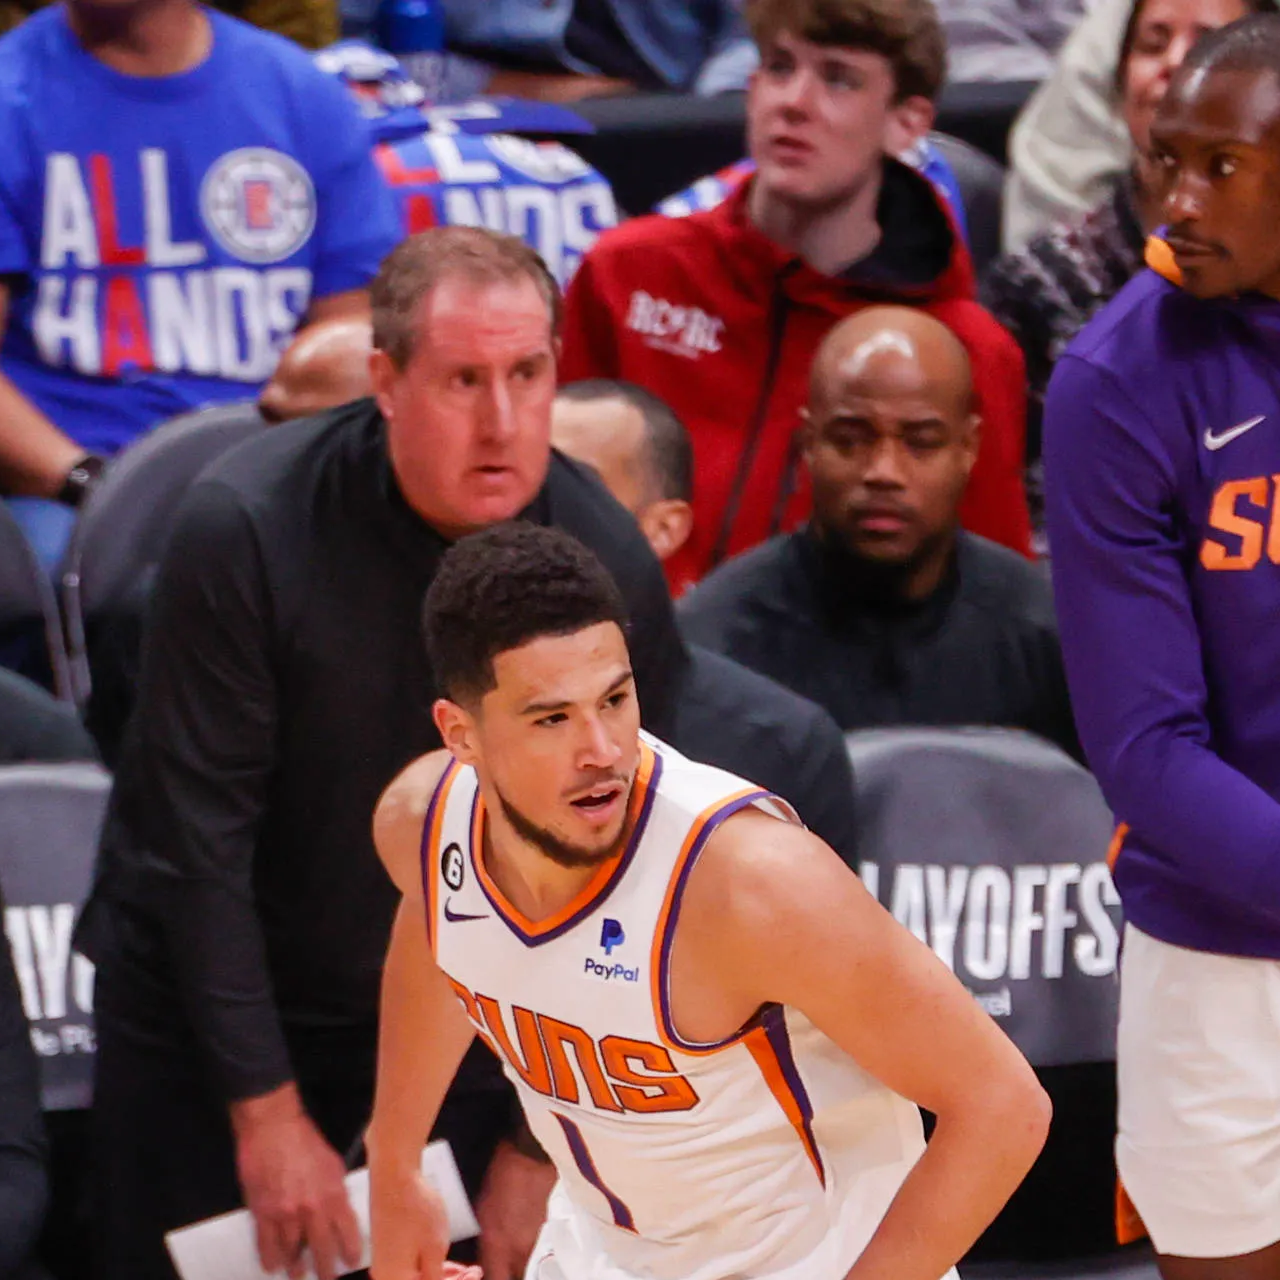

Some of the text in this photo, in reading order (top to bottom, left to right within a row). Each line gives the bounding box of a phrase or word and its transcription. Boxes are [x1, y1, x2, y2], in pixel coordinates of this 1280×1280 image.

[41, 148, 207, 269] ALL
[32, 268, 313, 382] HANDS
[584, 958, 639, 982] PayPal
[549, 1110, 639, 1235] 1
